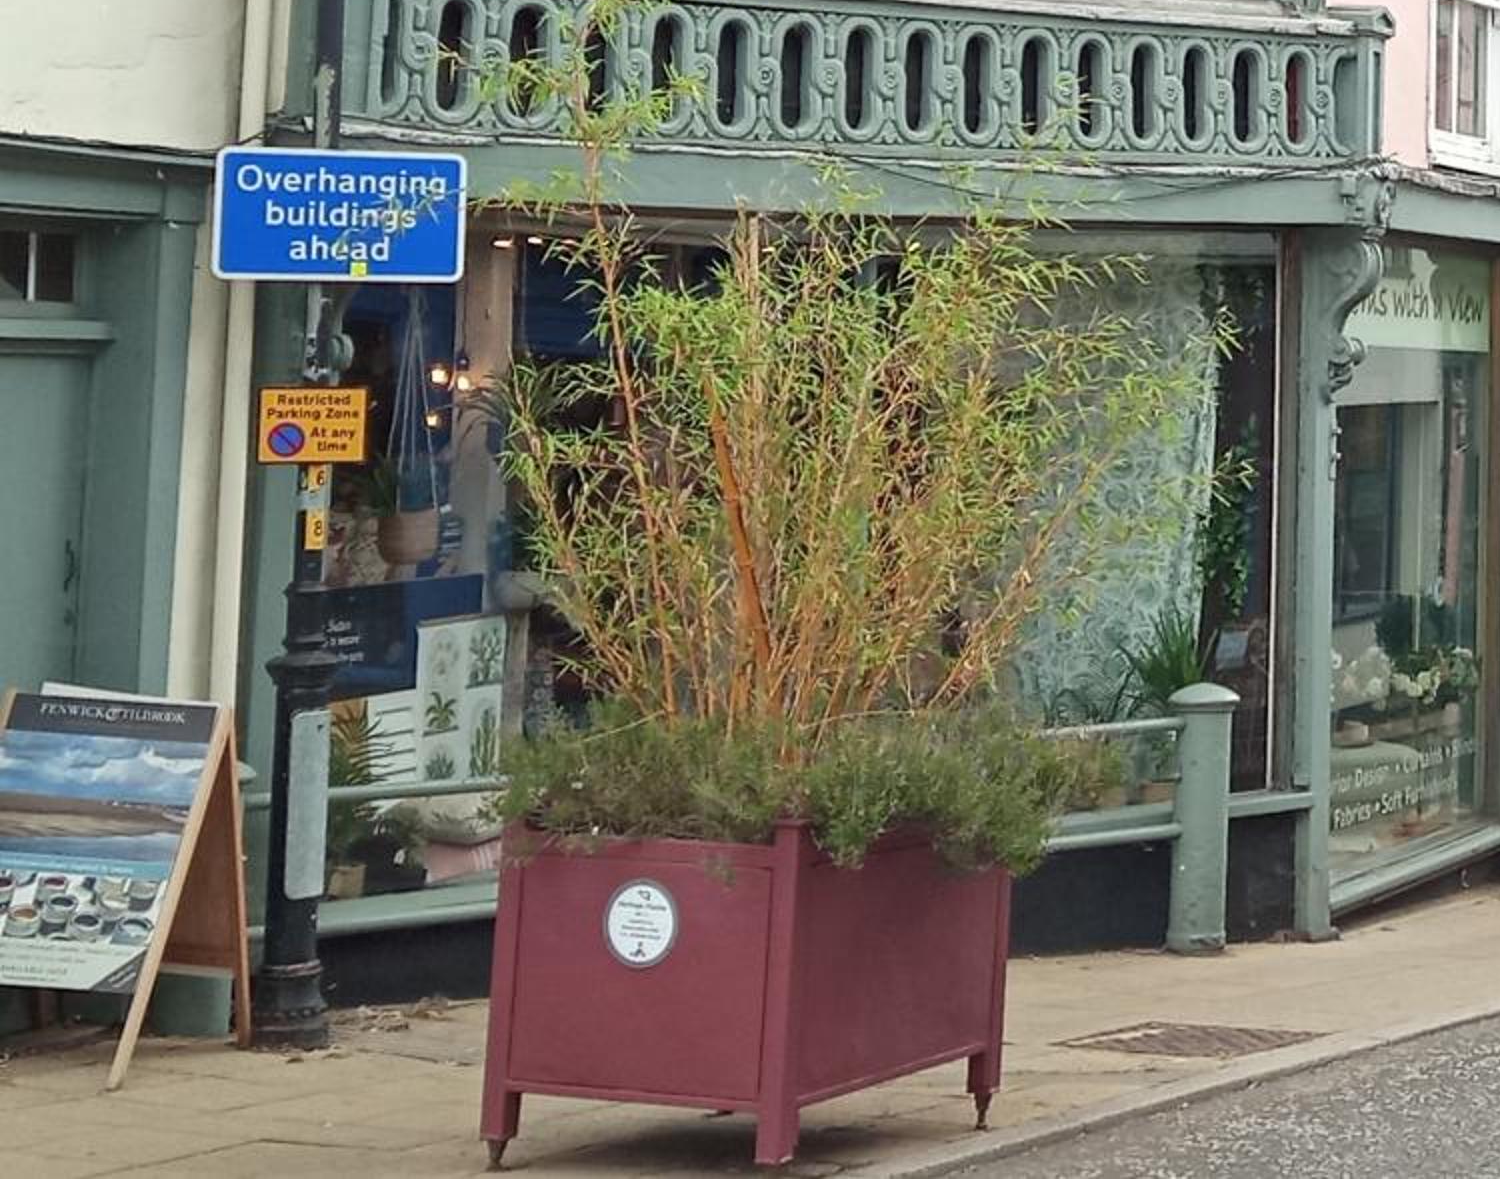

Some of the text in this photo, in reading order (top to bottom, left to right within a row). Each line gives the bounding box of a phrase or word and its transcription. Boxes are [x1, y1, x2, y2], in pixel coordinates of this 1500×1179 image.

[237, 164, 447, 201] Overhanging
[265, 200, 417, 233] buildings
[289, 235, 389, 262] ahead
[277, 394, 351, 406] Restricted
[267, 408, 359, 421] Parking Zone
[310, 427, 356, 440] At any
[317, 442, 348, 452] time
[39, 702, 104, 720] FENWICK
